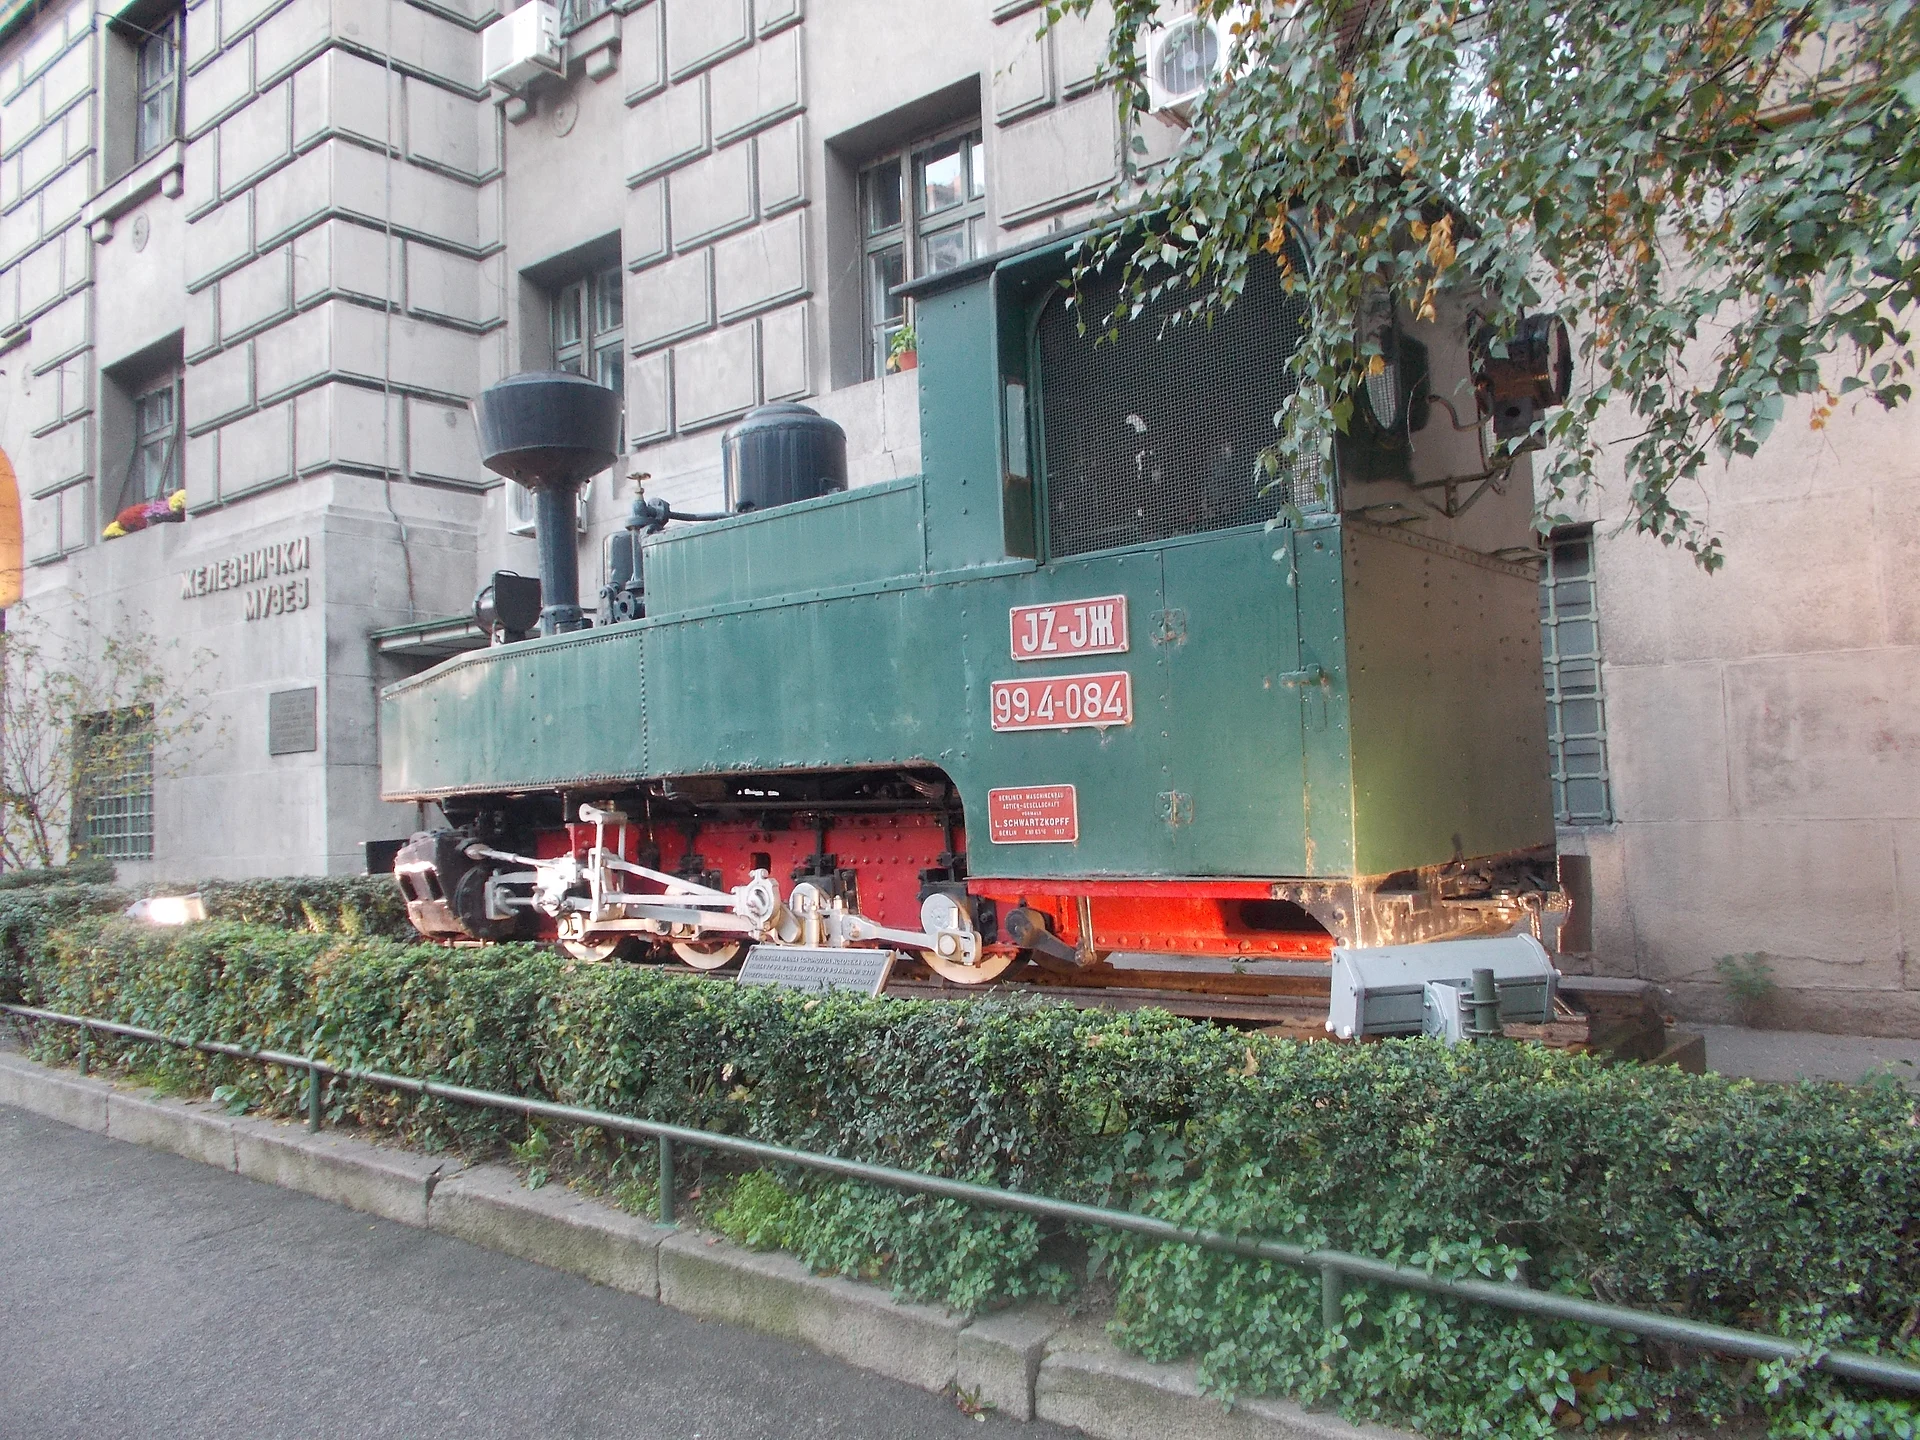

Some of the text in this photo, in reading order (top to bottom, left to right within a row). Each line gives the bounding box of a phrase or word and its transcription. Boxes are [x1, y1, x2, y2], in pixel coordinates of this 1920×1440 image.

[181, 536, 309, 600] ЖЕЛЕЗНИЧКИ
[244, 577, 309, 621] МУЗЕЈ
[995, 680, 1123, 723] 99.4-084
[1003, 817, 1070, 828] SCHWARTZKOPFF
